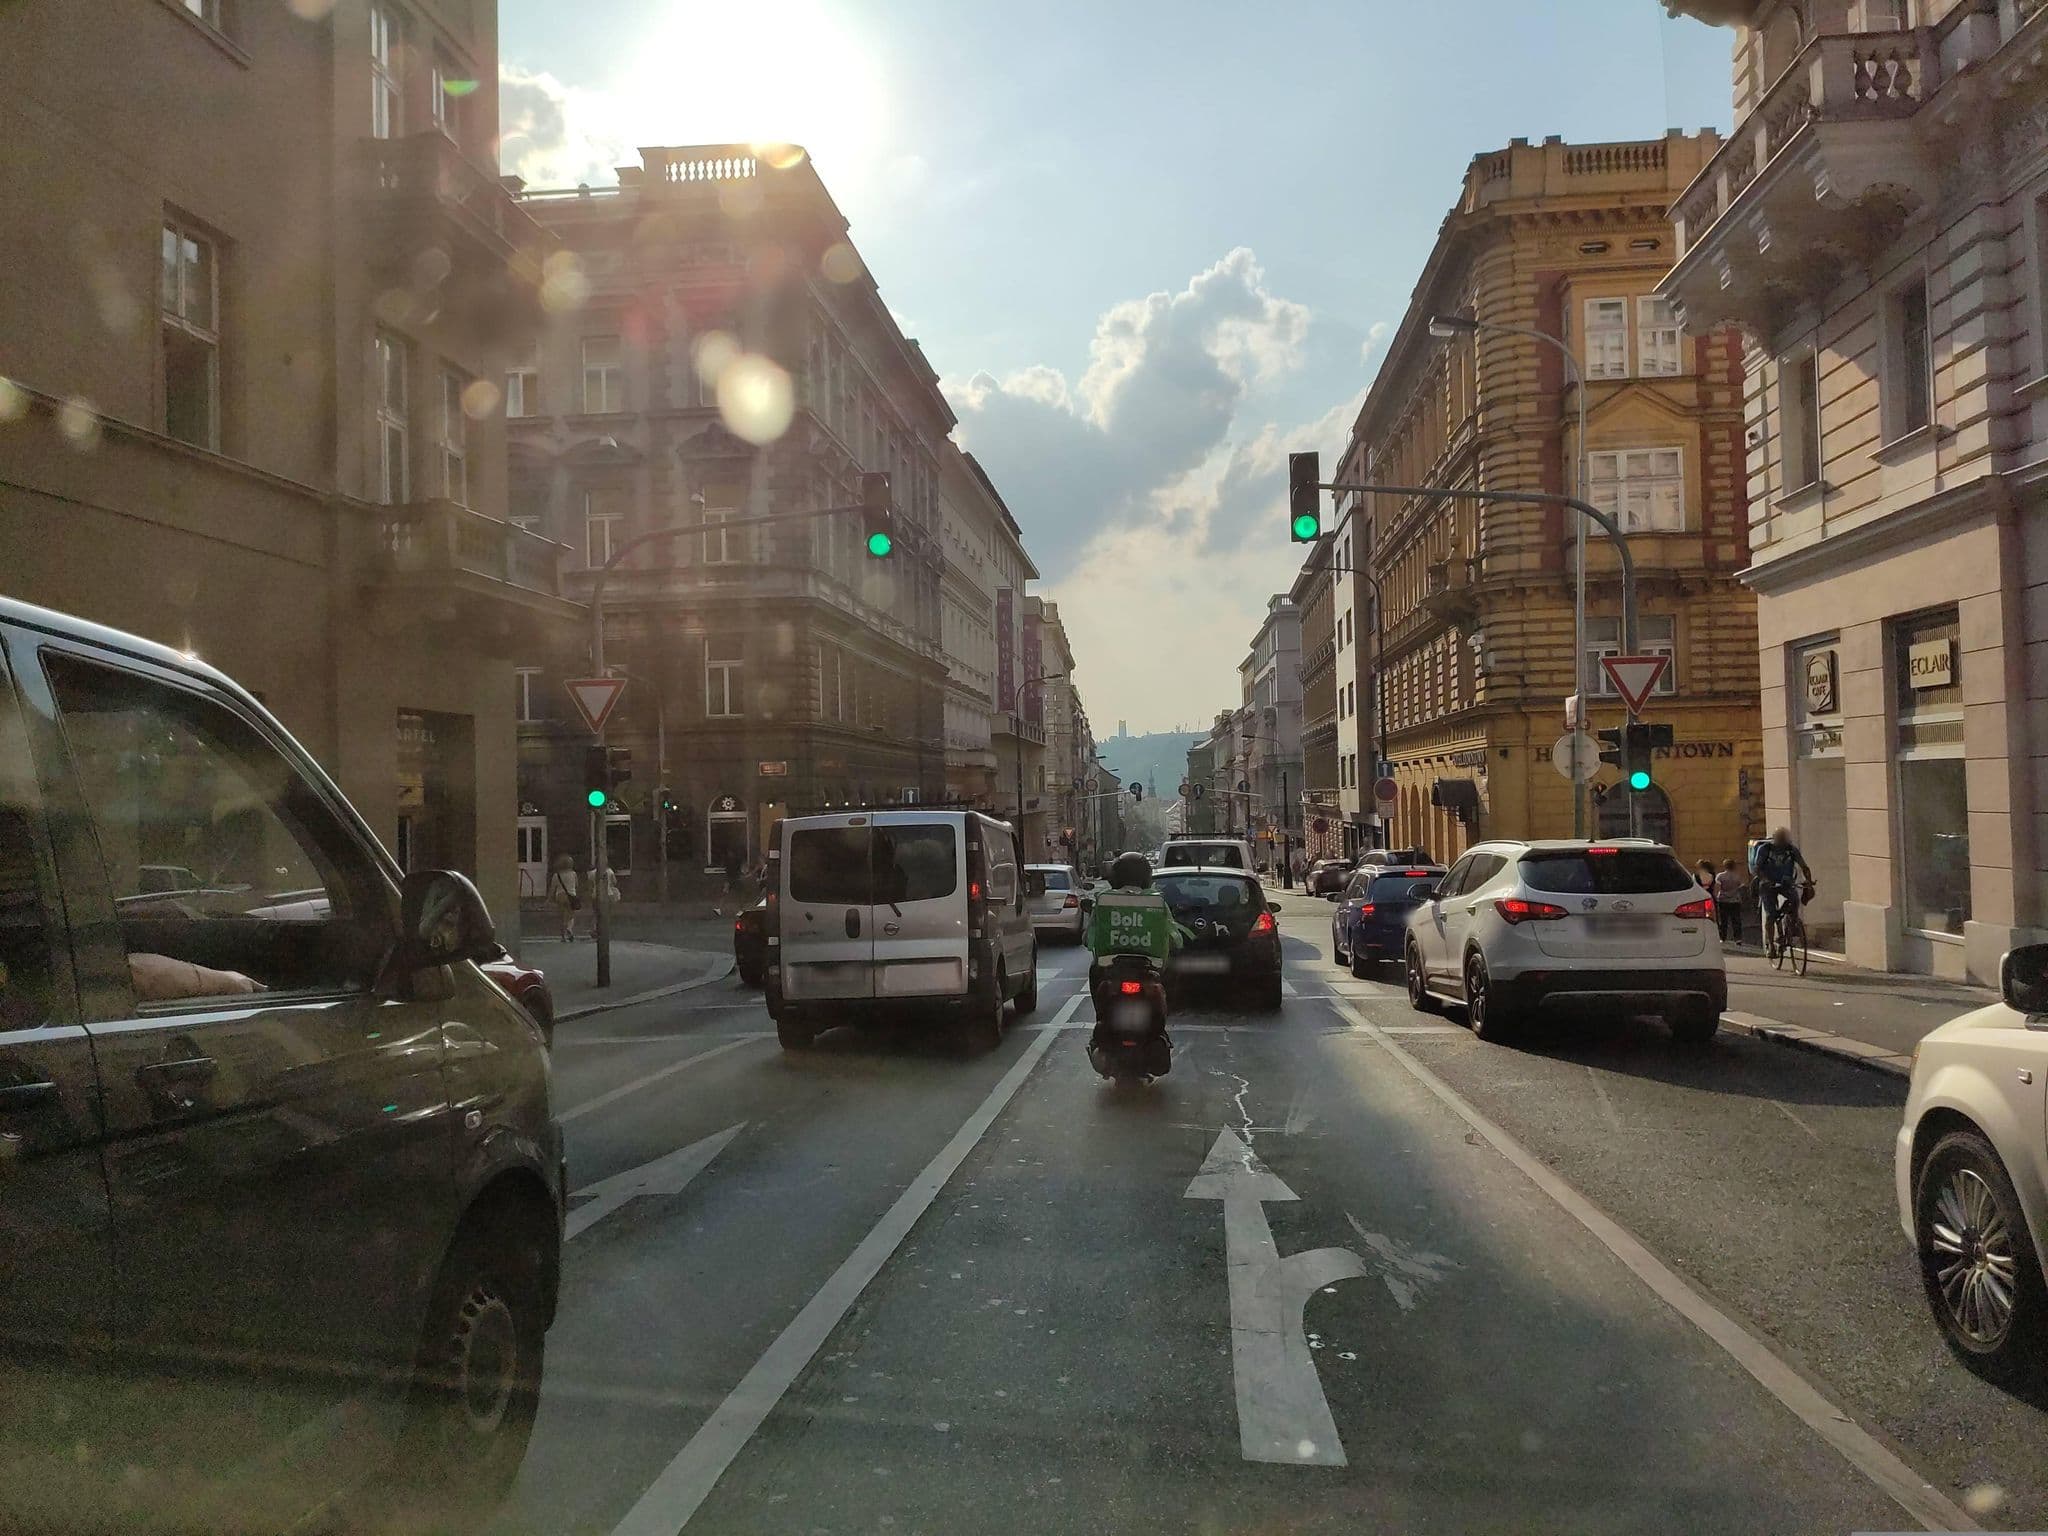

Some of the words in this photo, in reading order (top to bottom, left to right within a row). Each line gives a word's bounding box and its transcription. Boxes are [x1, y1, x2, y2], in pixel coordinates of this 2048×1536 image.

[1911, 653, 1950, 676] ECLAIR
[1111, 911, 1143, 928] Bolt
[1111, 930, 1151, 946] Food
